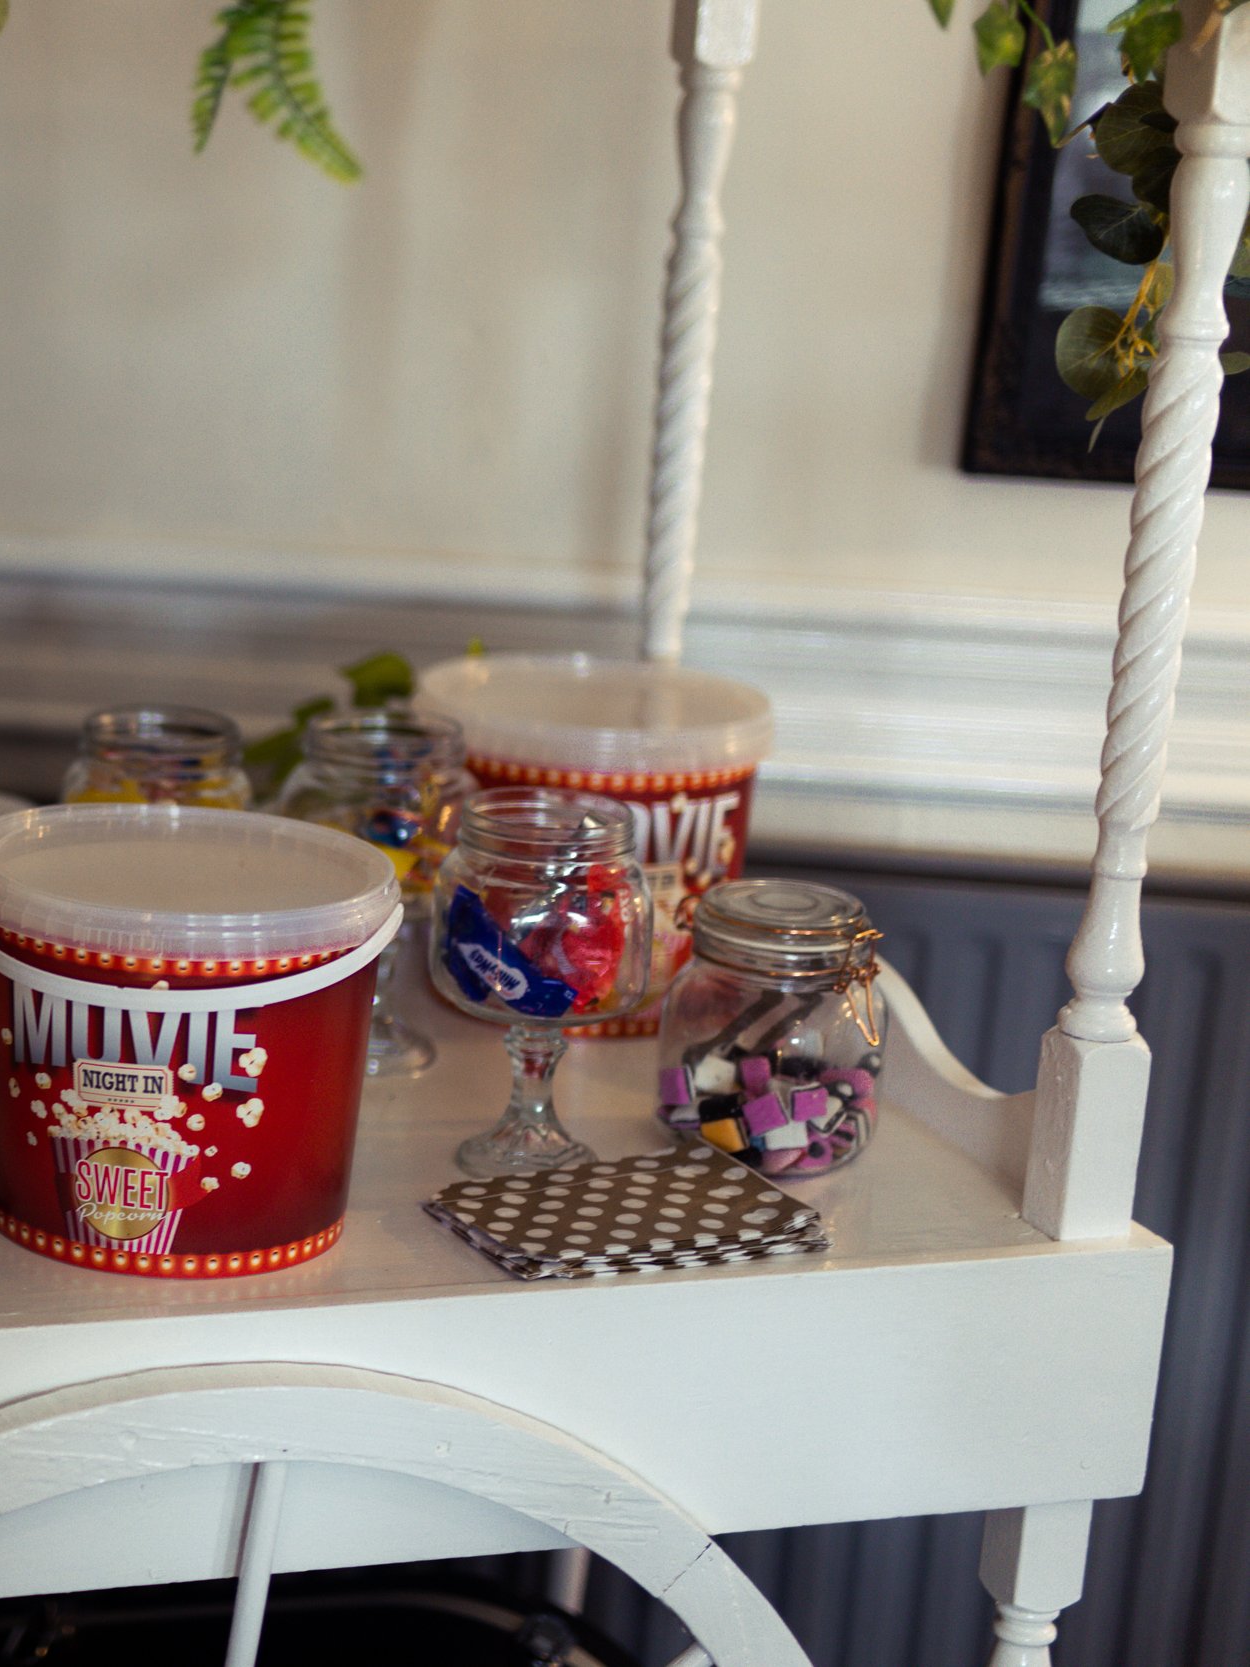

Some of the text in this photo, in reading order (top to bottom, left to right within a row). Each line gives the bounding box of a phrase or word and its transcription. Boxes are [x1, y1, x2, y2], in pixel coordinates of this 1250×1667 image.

[13, 980, 258, 1093] MOVIE
[82, 1068, 164, 1095] NIGHT IN
[76, 1159, 171, 1211] SWEET
[75, 1202, 167, 1225] Popcorn
